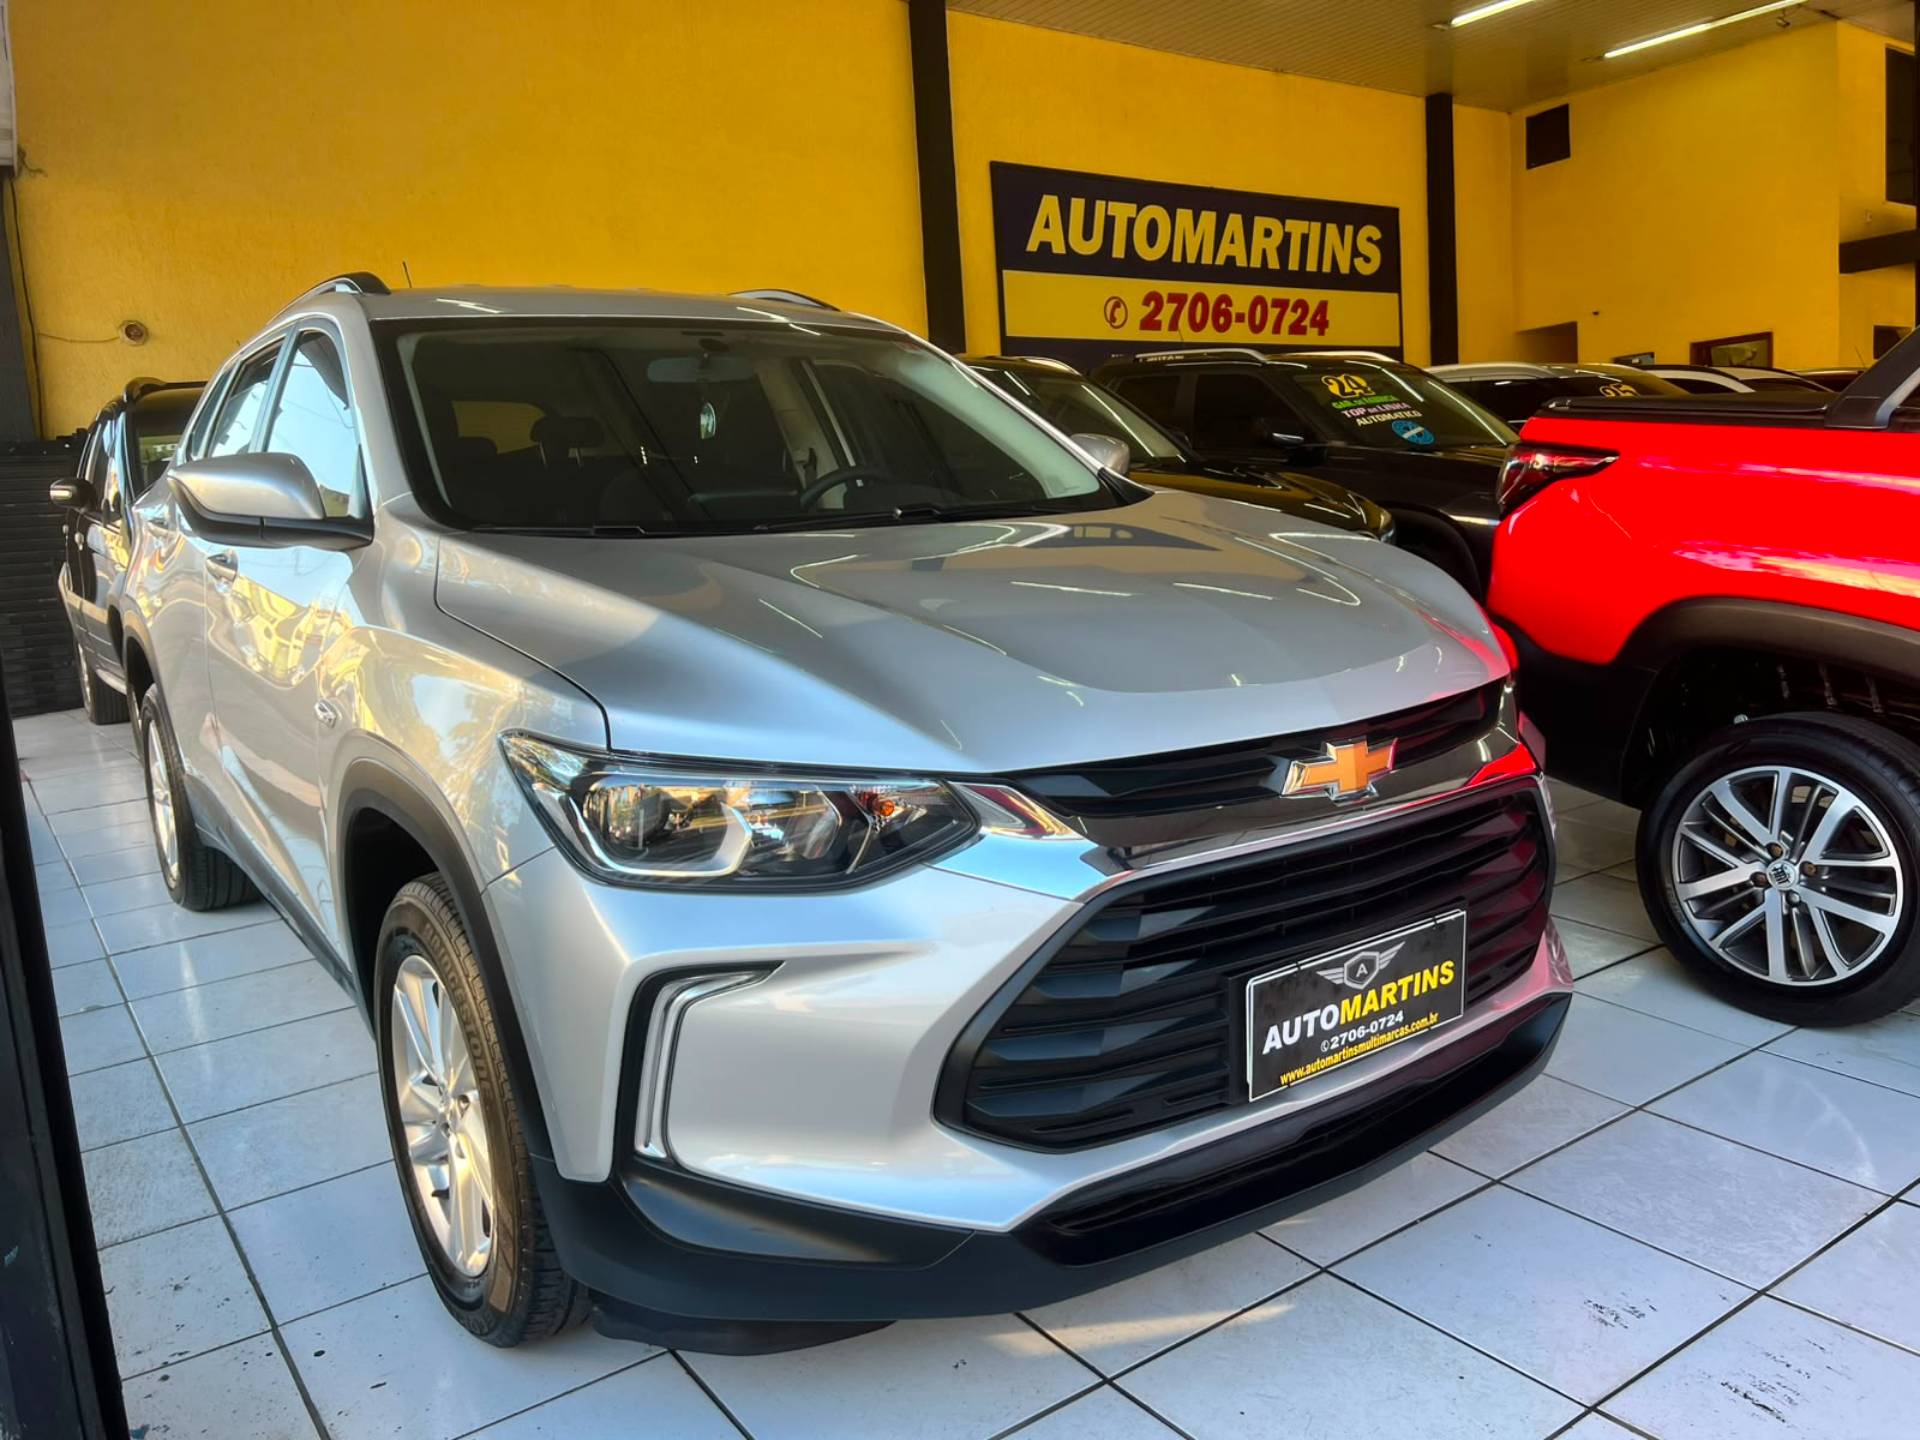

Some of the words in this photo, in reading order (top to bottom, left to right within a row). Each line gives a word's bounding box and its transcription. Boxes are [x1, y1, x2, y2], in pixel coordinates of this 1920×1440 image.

[1026, 194, 1382, 276] AUTOMARTINS
[1139, 290, 1330, 336] 2706-0724
[1321, 373, 1375, 398] 24
[1341, 407, 1367, 418] TOP
[1355, 962, 1369, 978] A
[1262, 960, 1455, 1055] AUTOMARTINS
[1279, 1011, 1440, 1086] www.automartinsmultimarcas.com.br
[1329, 1010, 1404, 1050] 2706-0724
